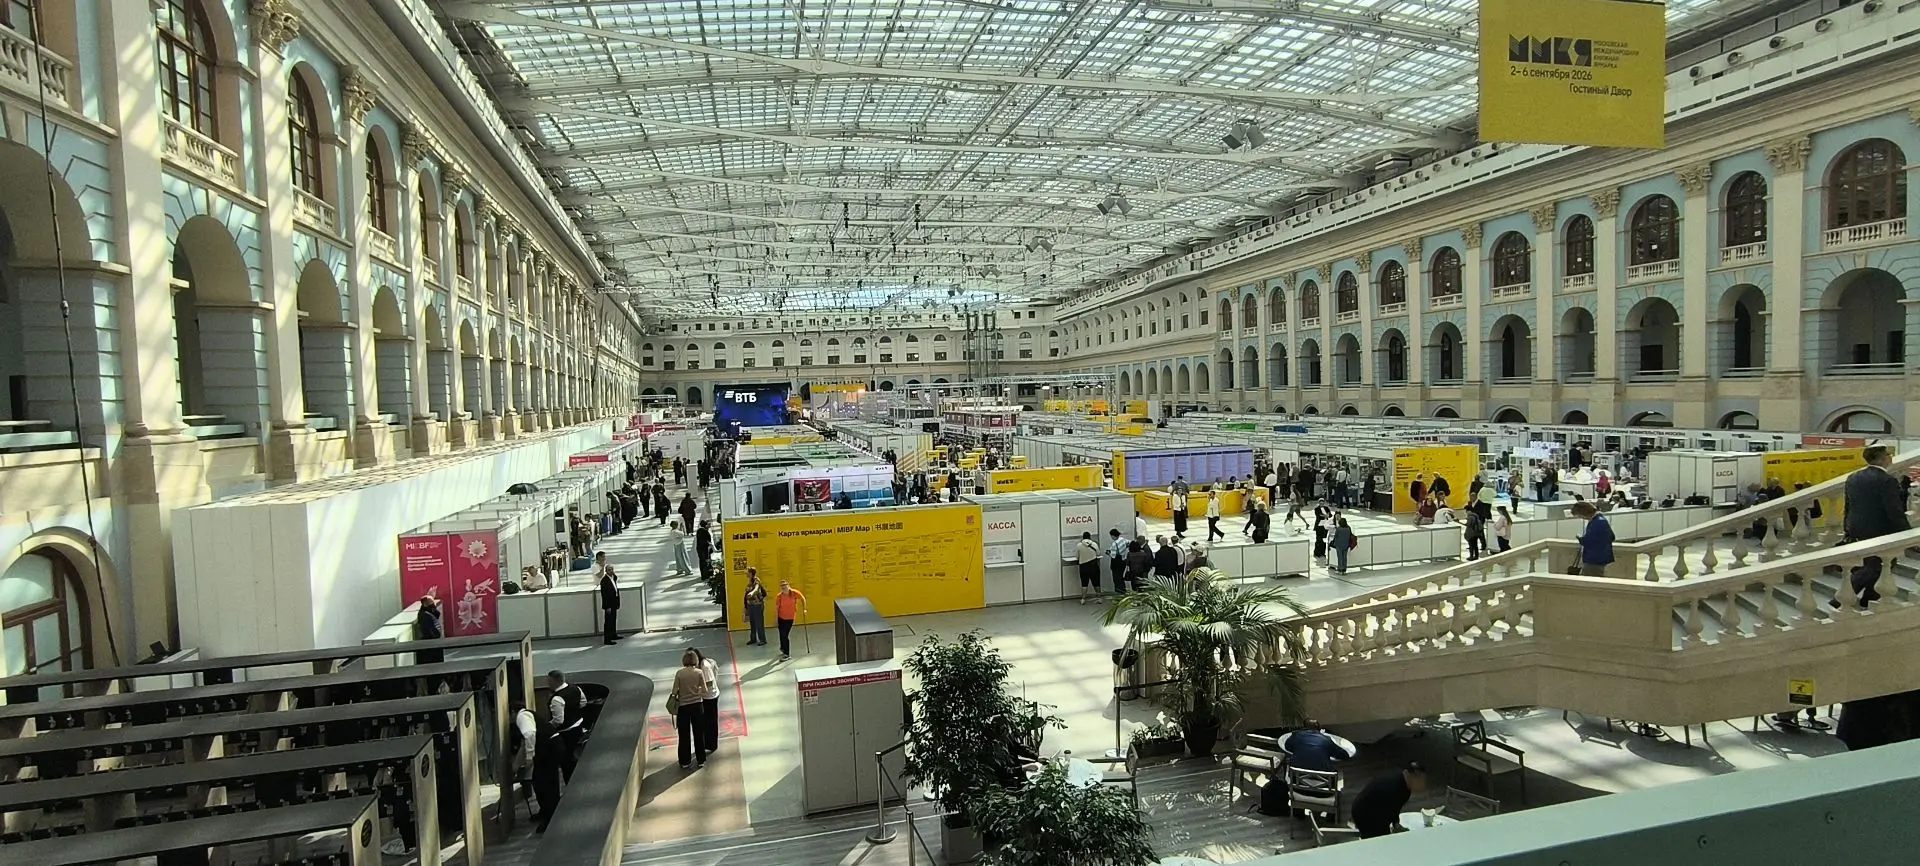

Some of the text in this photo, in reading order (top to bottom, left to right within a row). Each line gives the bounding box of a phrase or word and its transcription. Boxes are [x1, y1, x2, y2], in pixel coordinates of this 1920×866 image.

[1509, 34, 1592, 67] ММКЯ
[1530, 70, 1570, 82] сентября
[1571, 70, 1592, 80] 2026
[1570, 83, 1632, 99] Гостиный Двор
[735, 392, 757, 403] ВТБ
[1066, 516, 1093, 524] КАССА
[988, 522, 1016, 530] КАССА
[801, 528, 832, 537] ярмарки
